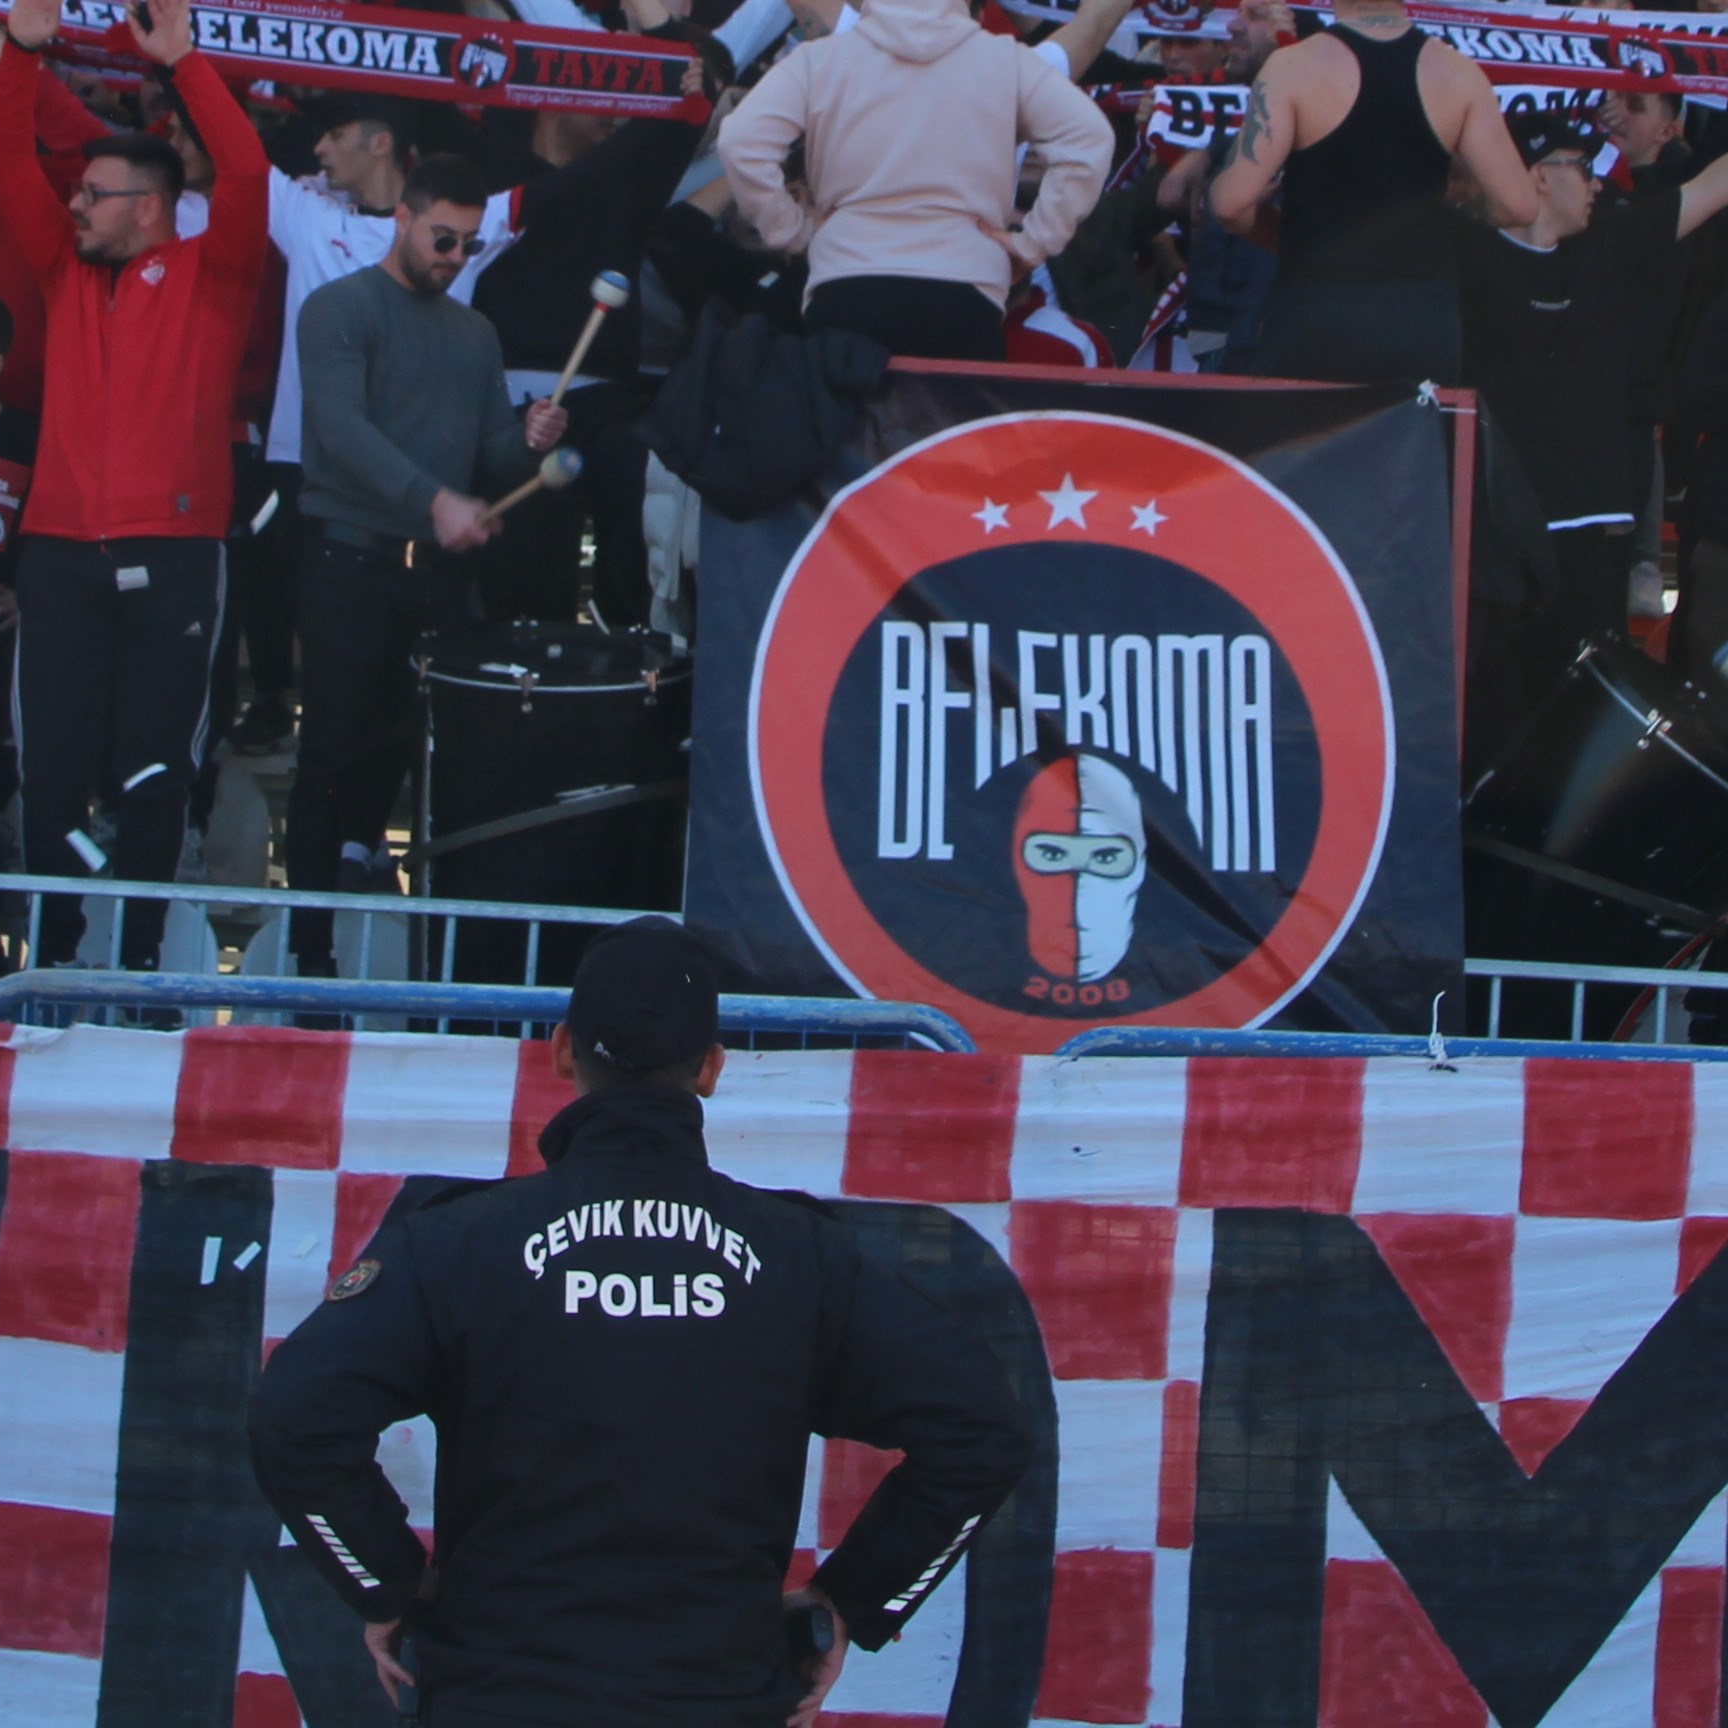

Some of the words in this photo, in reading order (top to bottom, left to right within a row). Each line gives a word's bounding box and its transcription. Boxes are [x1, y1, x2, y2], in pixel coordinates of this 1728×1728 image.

[188, 10, 441, 76] ELEKOMA
[530, 47, 665, 94] TAYFA
[878, 620, 1278, 873] BELEKOMA
[1021, 975, 1132, 1007] 2008
[632, 1199, 762, 1285] KUVVET
